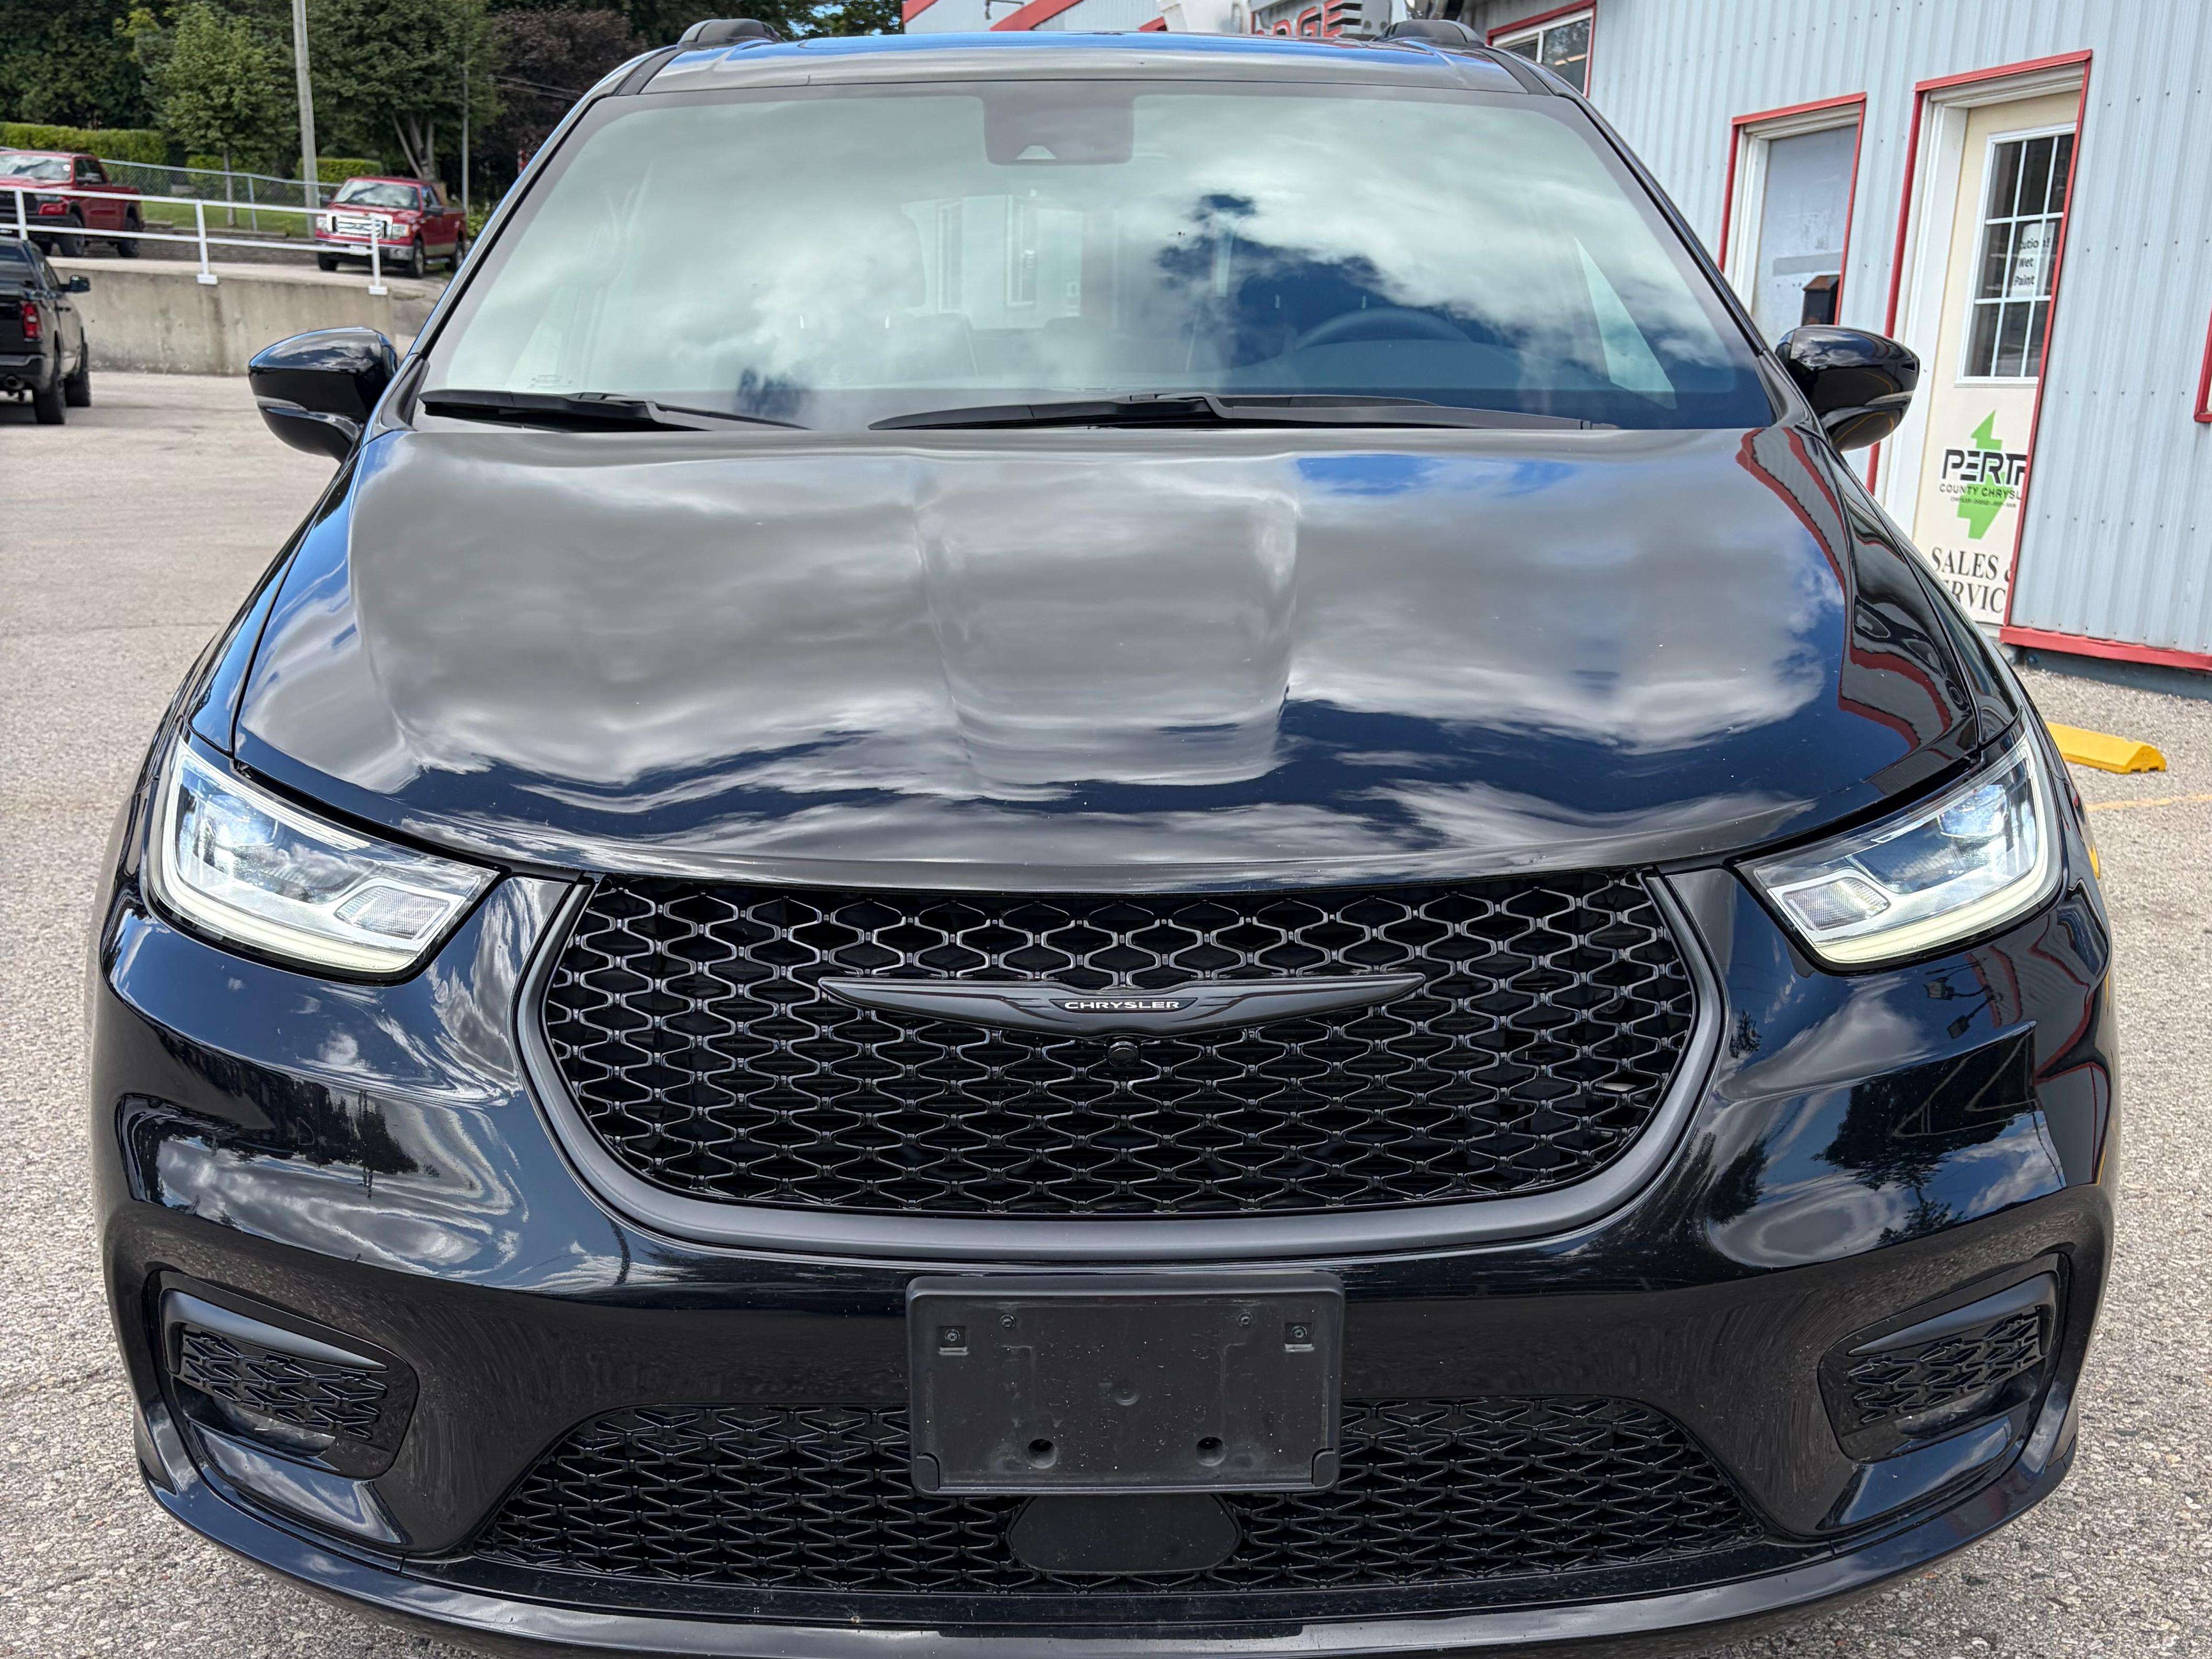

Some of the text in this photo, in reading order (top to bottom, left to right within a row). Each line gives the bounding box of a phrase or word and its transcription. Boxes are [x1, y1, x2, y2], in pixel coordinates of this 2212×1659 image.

[1939, 483, 1979, 495] COUNTY
[1931, 546, 1999, 580] SALES
[1942, 579, 2006, 613] RVIC
